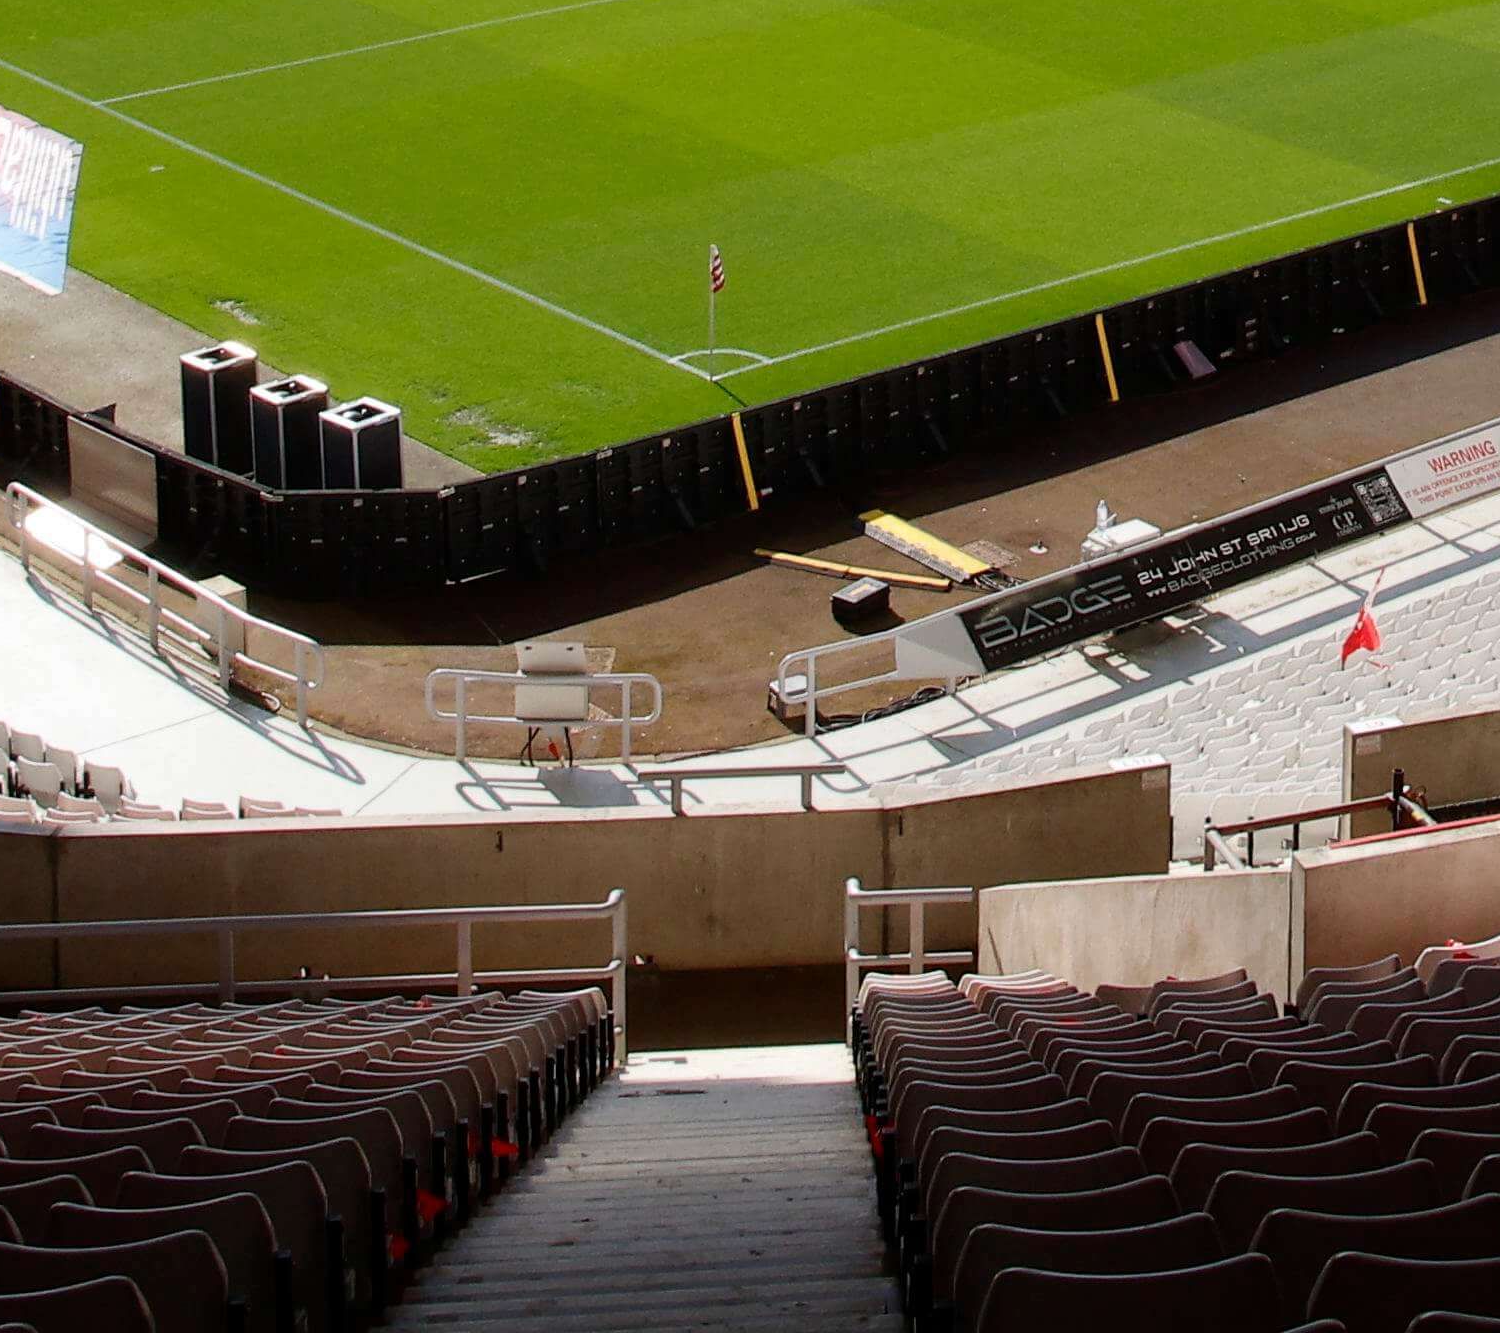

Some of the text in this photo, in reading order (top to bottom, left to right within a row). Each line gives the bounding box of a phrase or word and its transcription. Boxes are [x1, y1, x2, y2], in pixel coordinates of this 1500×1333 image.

[1427, 439, 1498, 474] WARNING
[1137, 566, 1164, 586] 24
[1166, 546, 1219, 576] JOHN
[1220, 537, 1243, 557] ST
[975, 574, 1133, 649] BADGE
